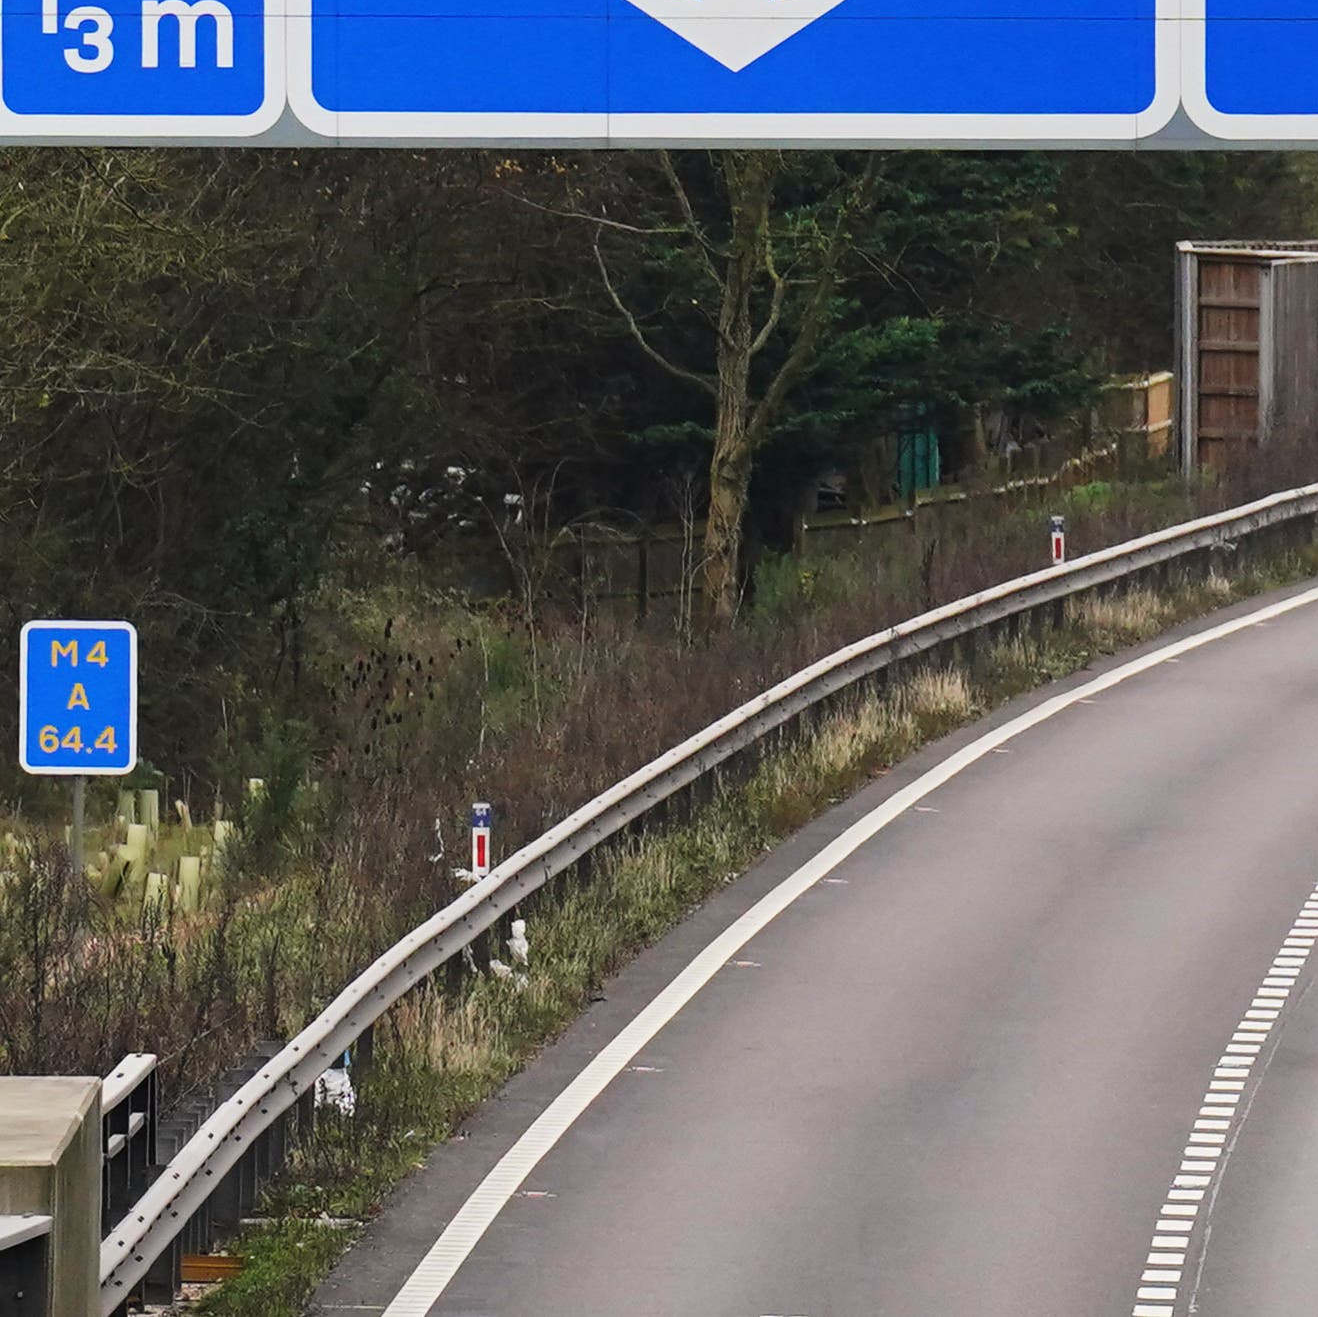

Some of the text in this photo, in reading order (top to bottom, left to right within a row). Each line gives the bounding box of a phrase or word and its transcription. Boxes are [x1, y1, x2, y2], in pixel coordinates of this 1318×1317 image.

[142, 0, 234, 68] m
[66, 682, 91, 710] A
[38, 725, 118, 754] 64.4
